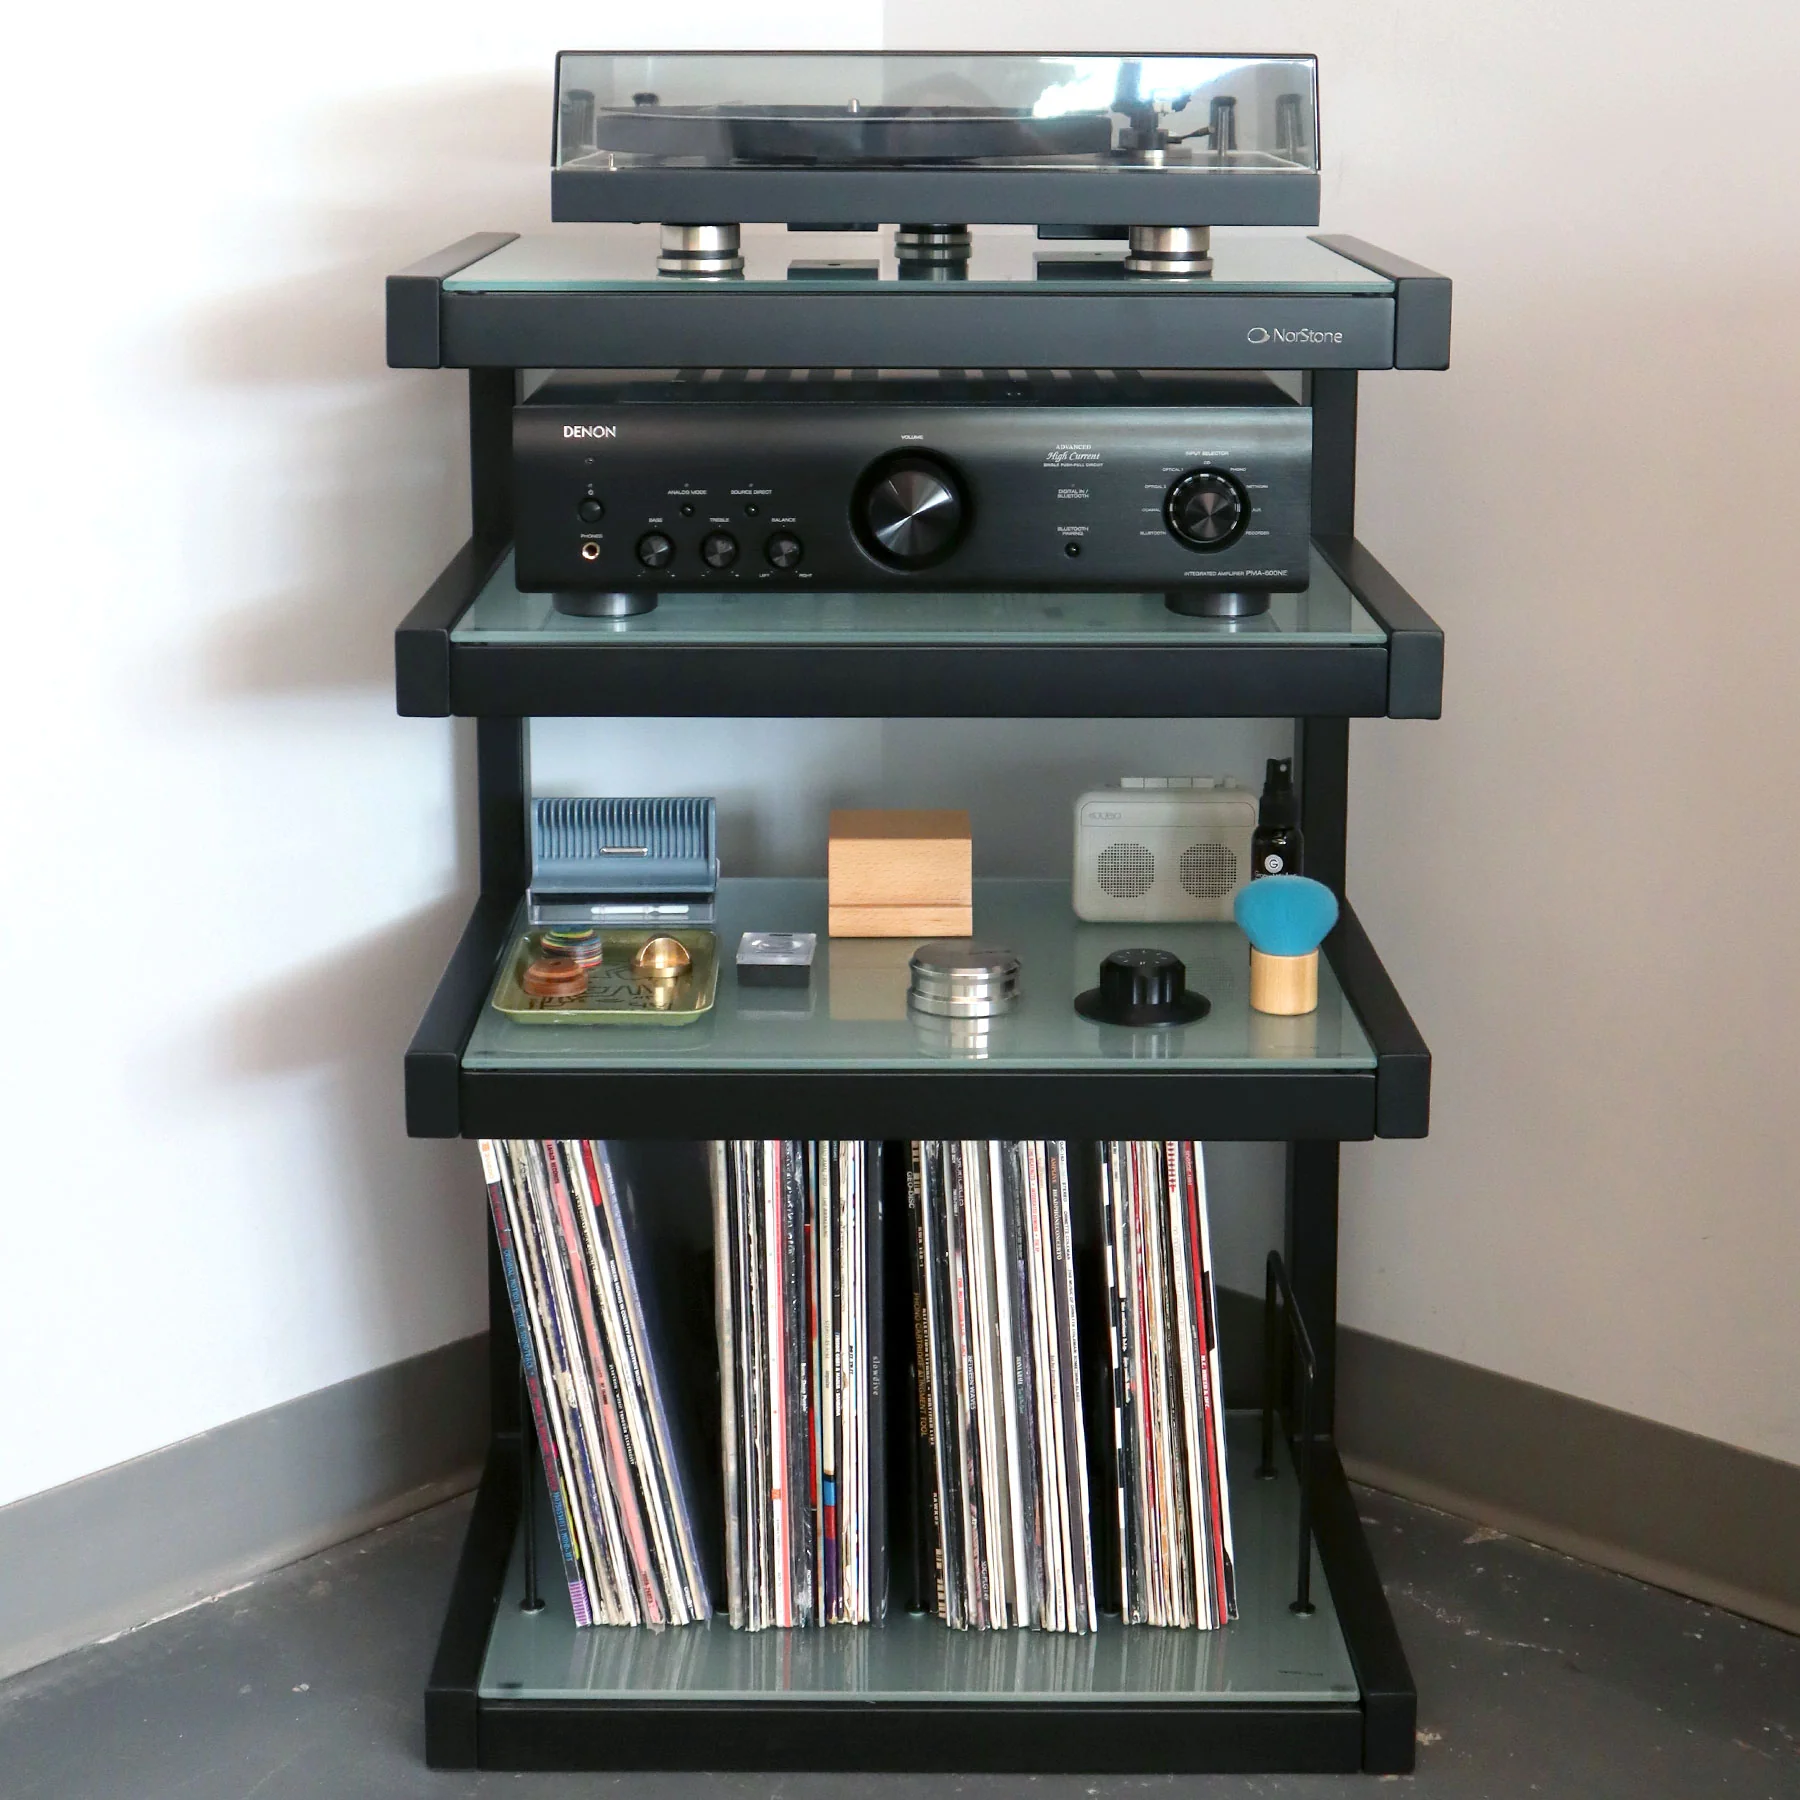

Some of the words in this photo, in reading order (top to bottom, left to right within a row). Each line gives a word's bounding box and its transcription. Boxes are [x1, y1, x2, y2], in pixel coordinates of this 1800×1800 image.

[1273, 328, 1343, 343] NorStone
[563, 425, 617, 438] DENON
[1045, 451, 1068, 463] High
[1068, 451, 1100, 461] Current
[1269, 859, 1279, 869] G
[906, 1171, 914, 1208] GEO-DISC
[912, 1292, 922, 1320] PHONO
[913, 1322, 925, 1366] CARTRIDGE
[871, 1355, 881, 1395] slowdive
[919, 1416, 927, 1436] TOOL
